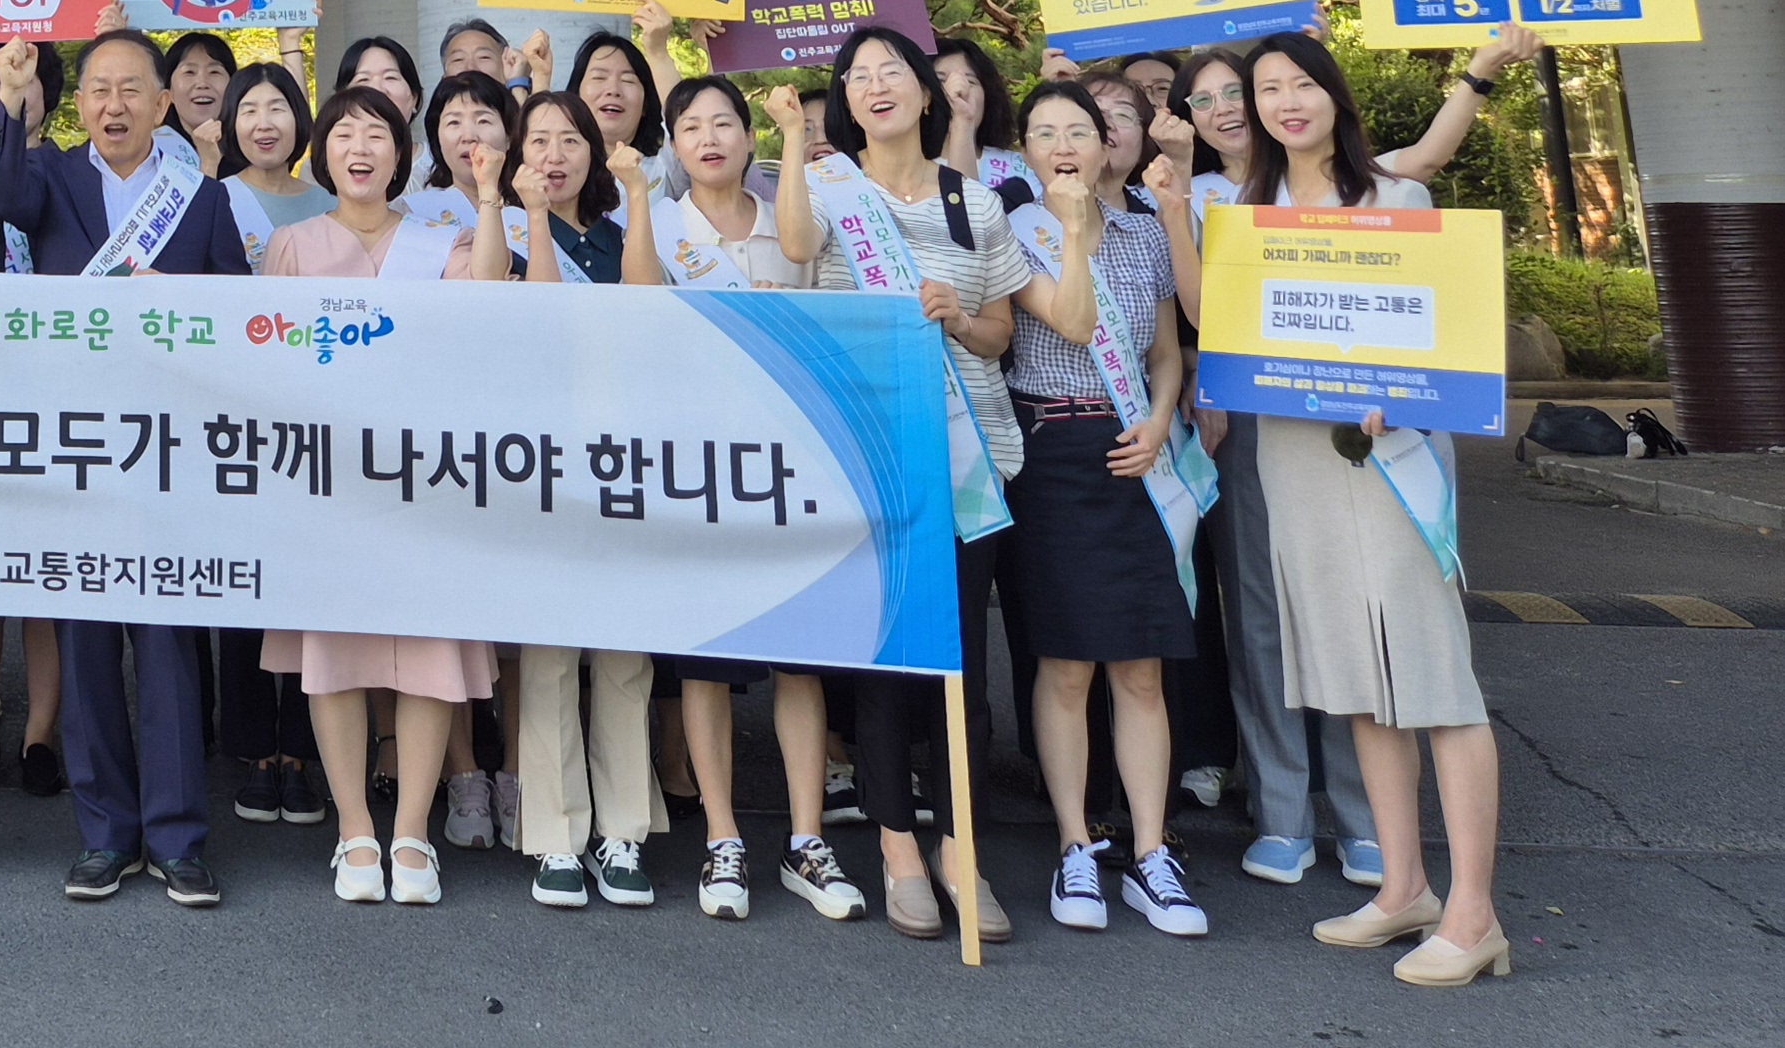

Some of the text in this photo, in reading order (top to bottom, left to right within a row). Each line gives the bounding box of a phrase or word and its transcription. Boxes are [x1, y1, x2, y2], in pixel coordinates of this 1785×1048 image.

[751, 0, 876, 26] 학교폭력 멈춰!
[1416, 4, 1447, 18] 최대
[832, 22, 856, 34] OUT
[798, 45, 842, 58] 진주교육지
[137, 187, 185, 256] 학교폭력
[1262, 248, 1401, 267] 어차피 가짜니까 괜찮다?
[320, 298, 367, 312] 경남교육
[1272, 290, 1423, 315] 피해자가 받는 고통은
[1271, 311, 1355, 332] 진짜입니다.
[138, 308, 216, 352] 학교
[246, 312, 394, 364] 아이좋아
[1093, 324, 1131, 398] 교폭력
[1263, 362, 1311, 376] 호기심이나
[1313, 365, 1352, 379] 장난으로
[203, 413, 332, 497] 함께
[361, 427, 563, 514] 나서야
[585, 433, 818, 526] 합니다.
